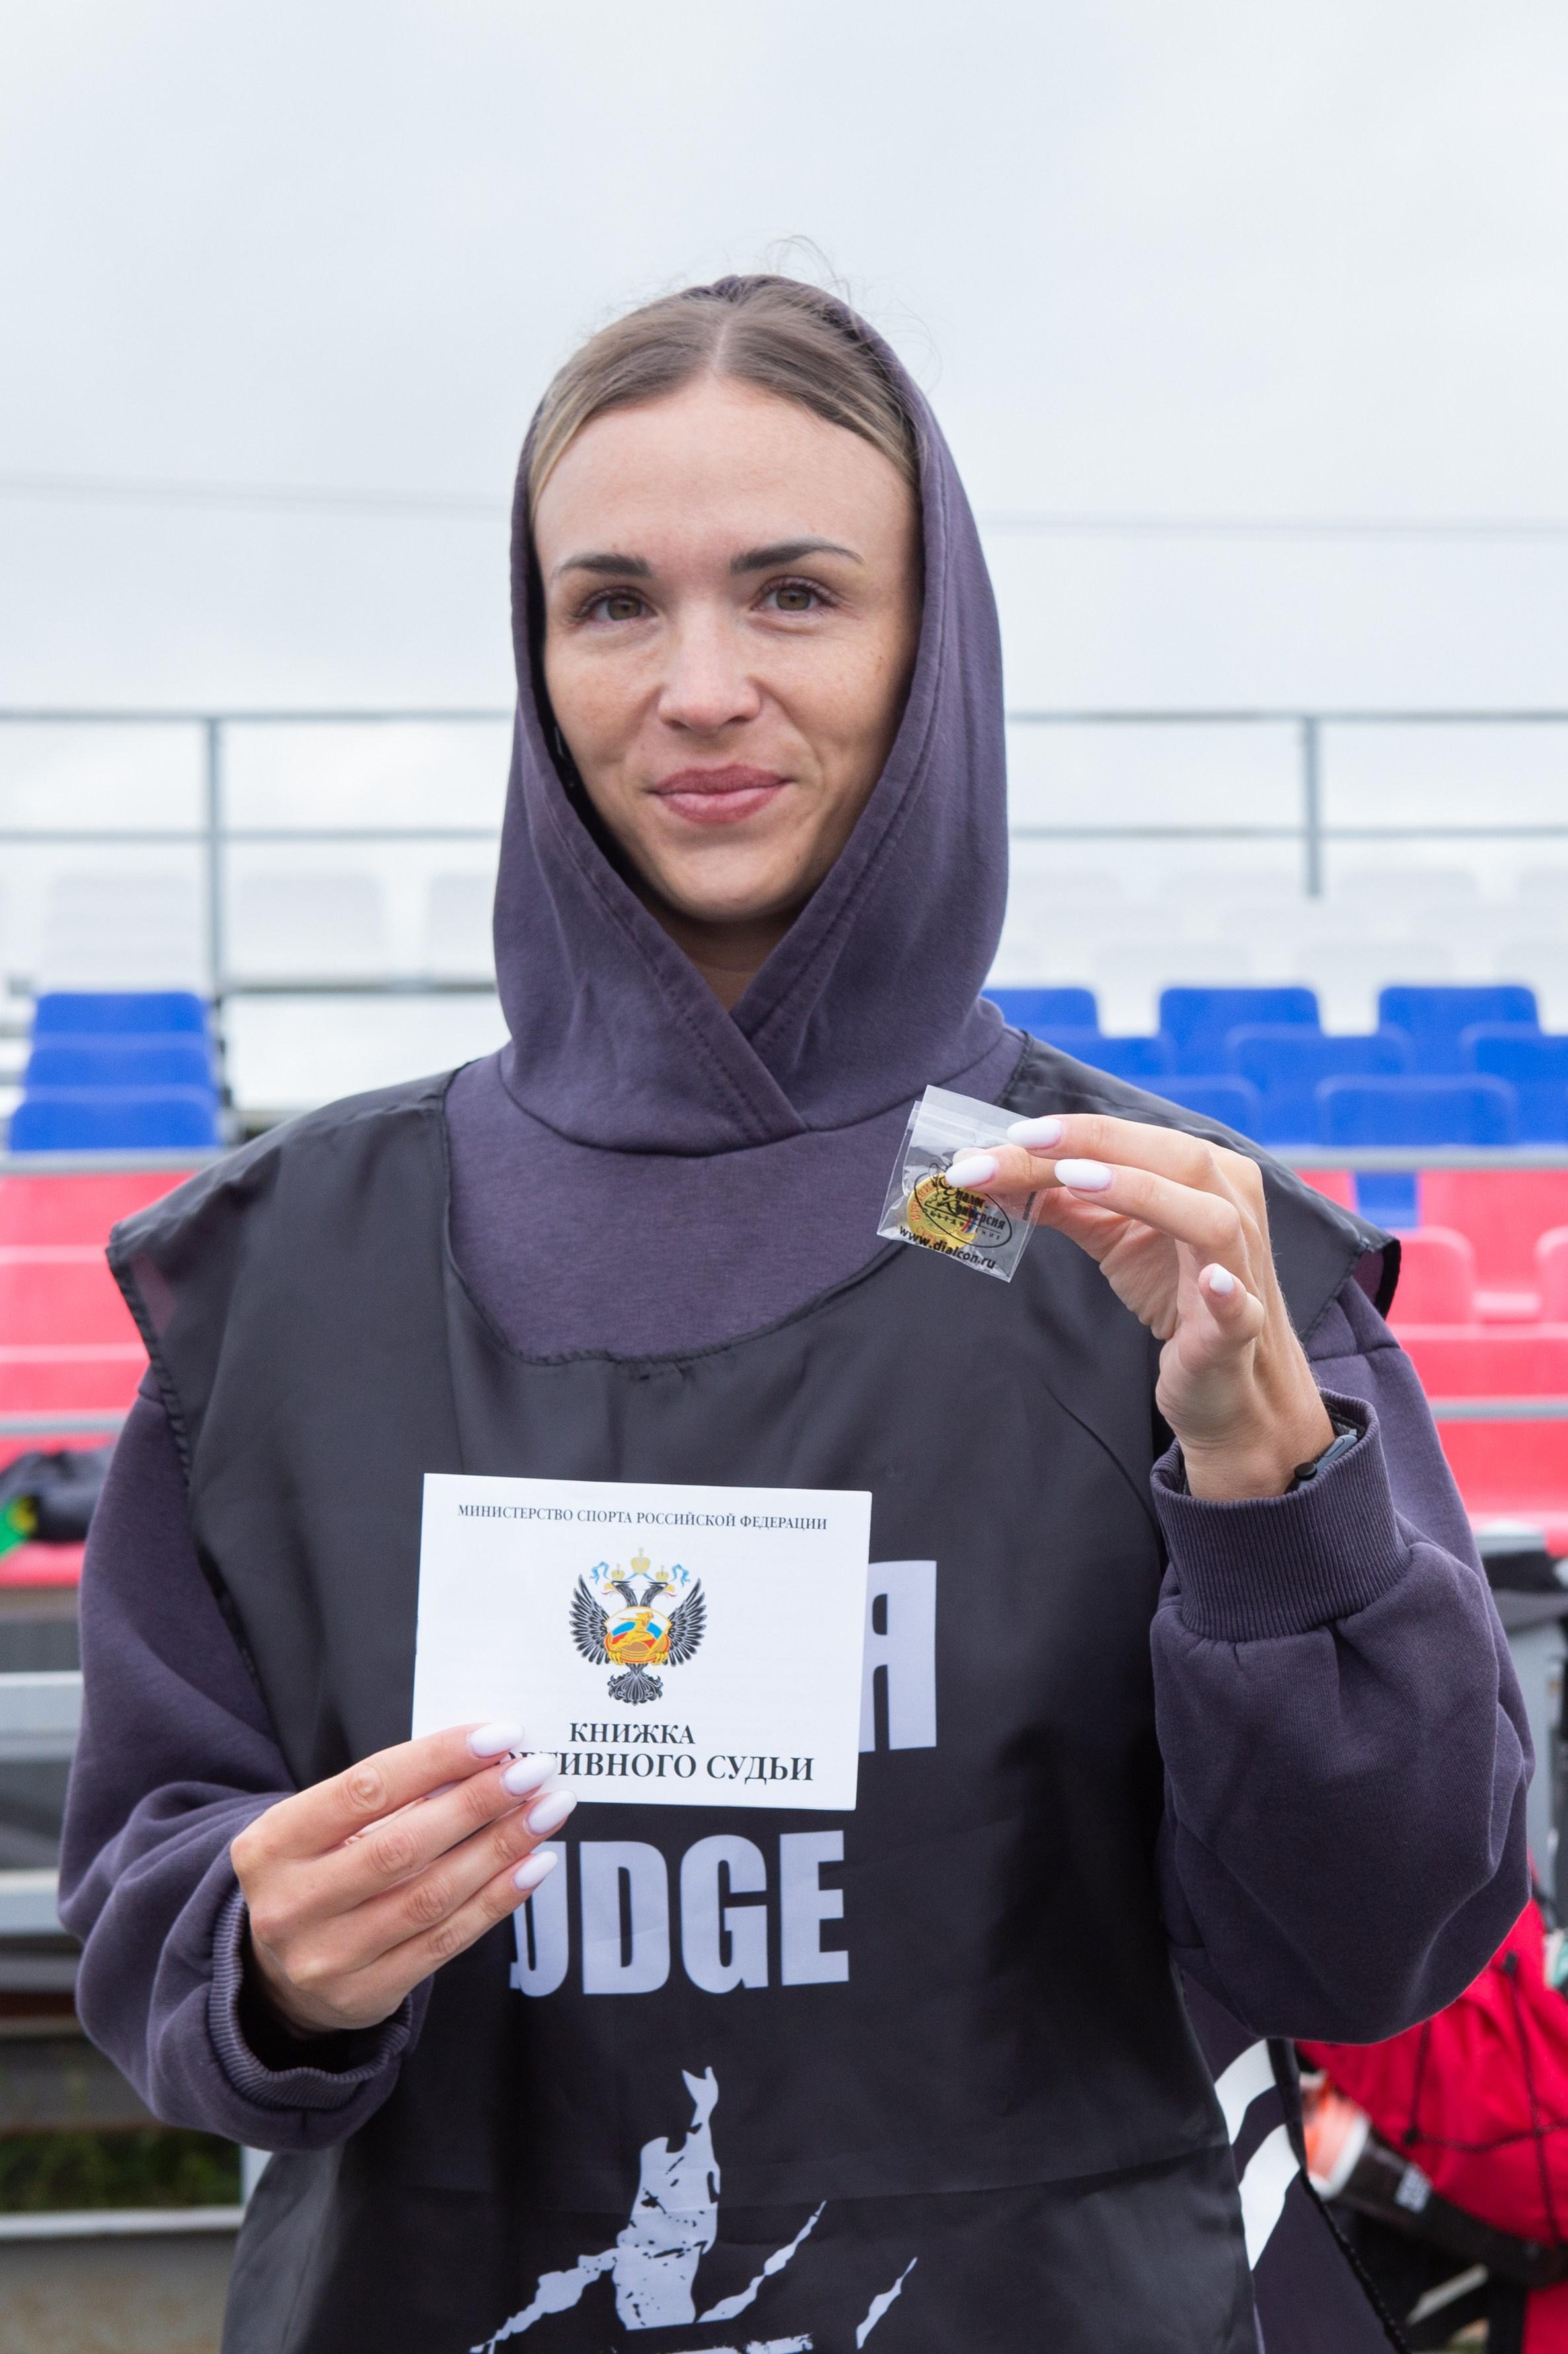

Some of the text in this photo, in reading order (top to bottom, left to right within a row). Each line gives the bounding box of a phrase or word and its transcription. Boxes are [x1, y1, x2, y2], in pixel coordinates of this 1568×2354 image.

[899, 1225, 996, 1269] www.dialcon.ru
[457, 1504, 828, 1531] МИНИСТЕРСТВО СПОРТА РОССИЙСКОЙ ФЕДЕРАЦИИ
[568, 1722, 696, 1745] КНИЖКА
[706, 1754, 815, 1786] СУДЬИ
